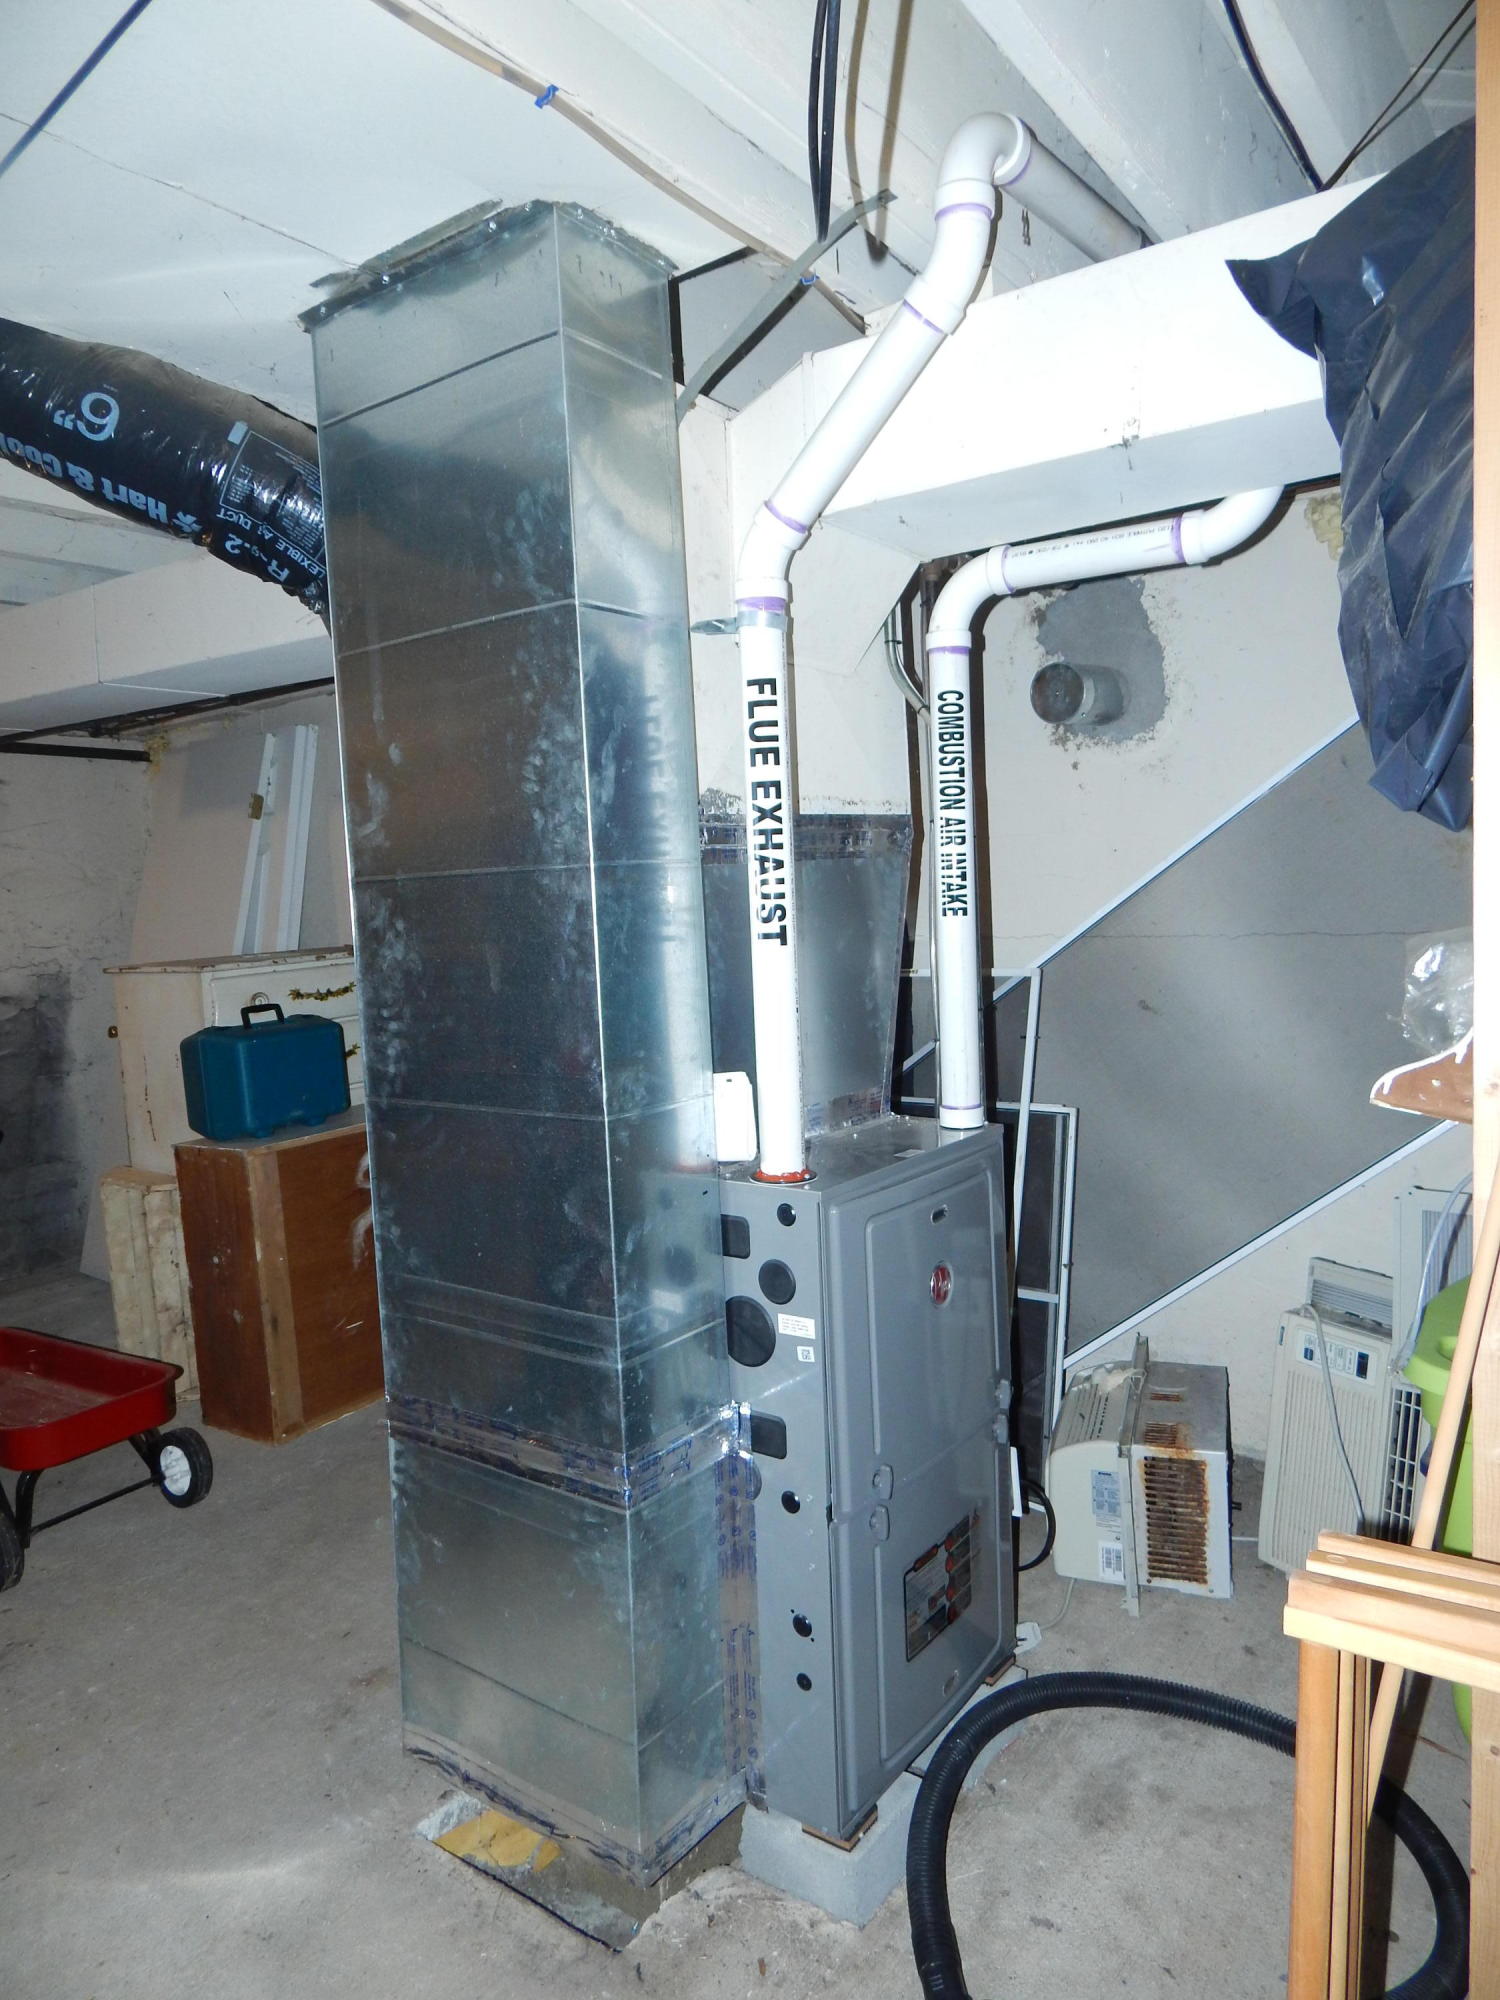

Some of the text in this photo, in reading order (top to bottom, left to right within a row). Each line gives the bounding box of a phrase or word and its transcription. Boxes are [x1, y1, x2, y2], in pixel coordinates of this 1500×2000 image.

[66, 461, 94, 492] &
[101, 476, 169, 524] Hart
[216, 508, 252, 531] DUCT
[275, 539, 325, 578] LEXIBLE
[746, 677, 788, 946] FLUE EXHAUST
[937, 689, 968, 917] COMBUSTION AIR INTAKE
